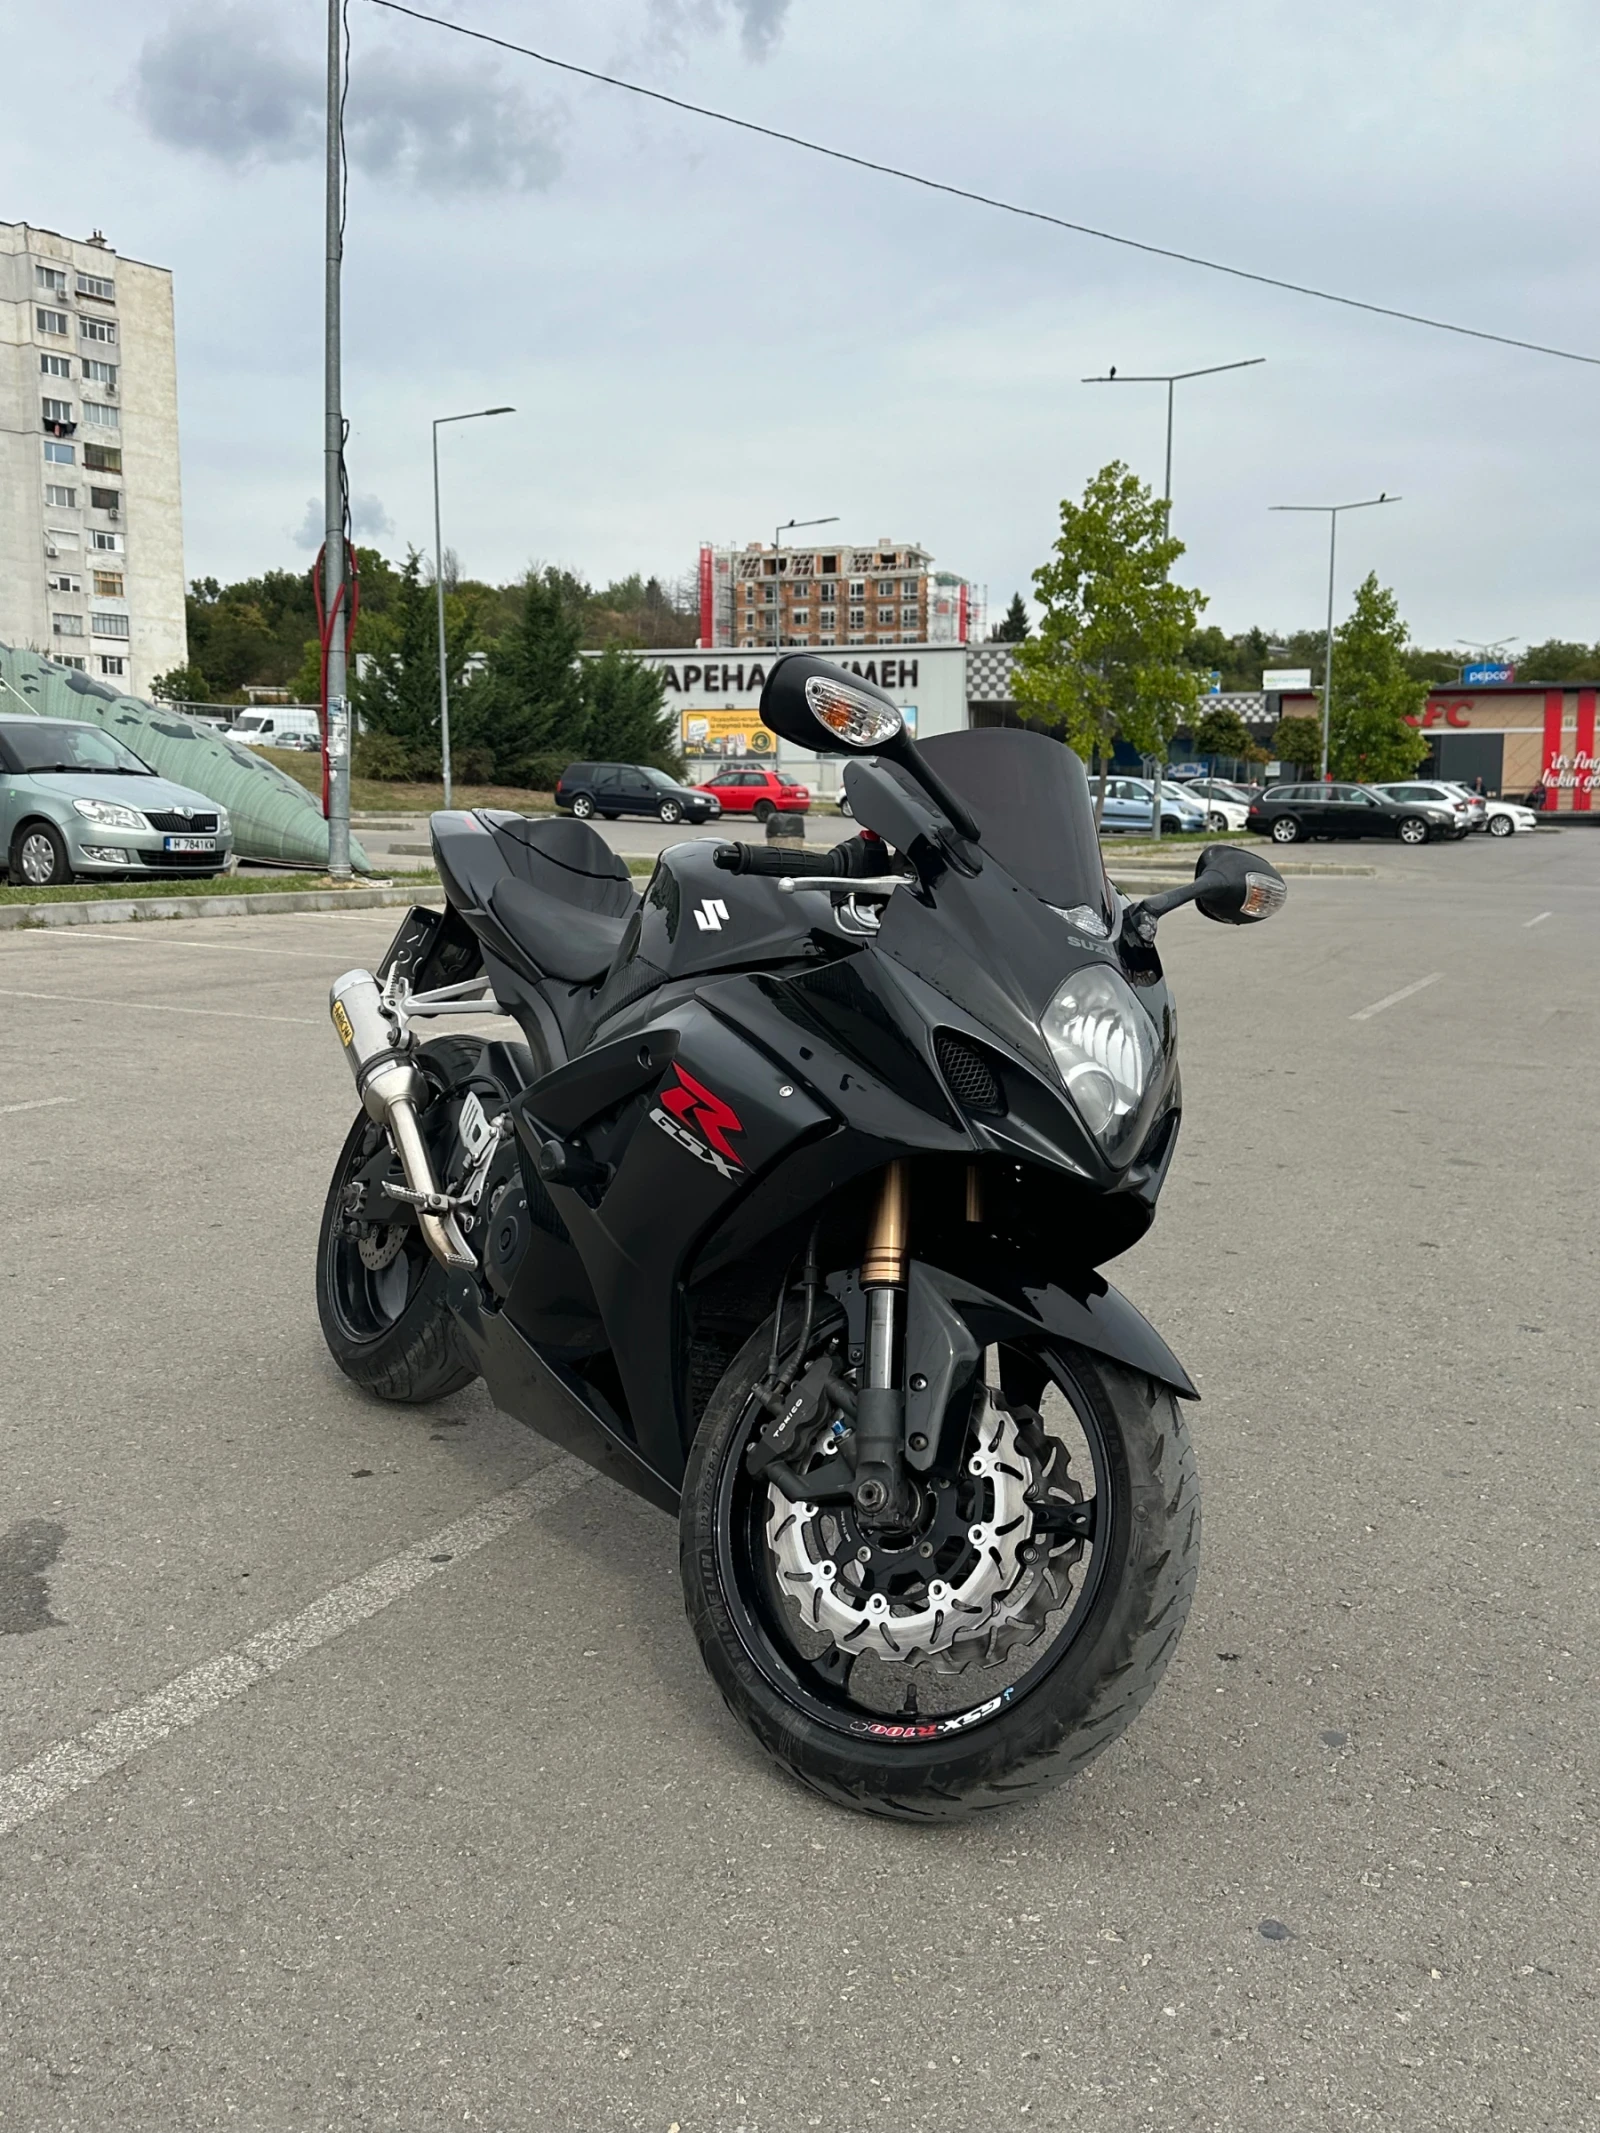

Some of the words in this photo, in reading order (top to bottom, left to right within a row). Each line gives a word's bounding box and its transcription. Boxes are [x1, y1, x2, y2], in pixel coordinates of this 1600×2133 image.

[662, 663, 767, 692] АРЕНА
[842, 659, 919, 688] МЕН
[1469, 671, 1508, 684] pepco
[649, 1108, 744, 1179] GSX
[772, 1398, 803, 1438] TOKICO
